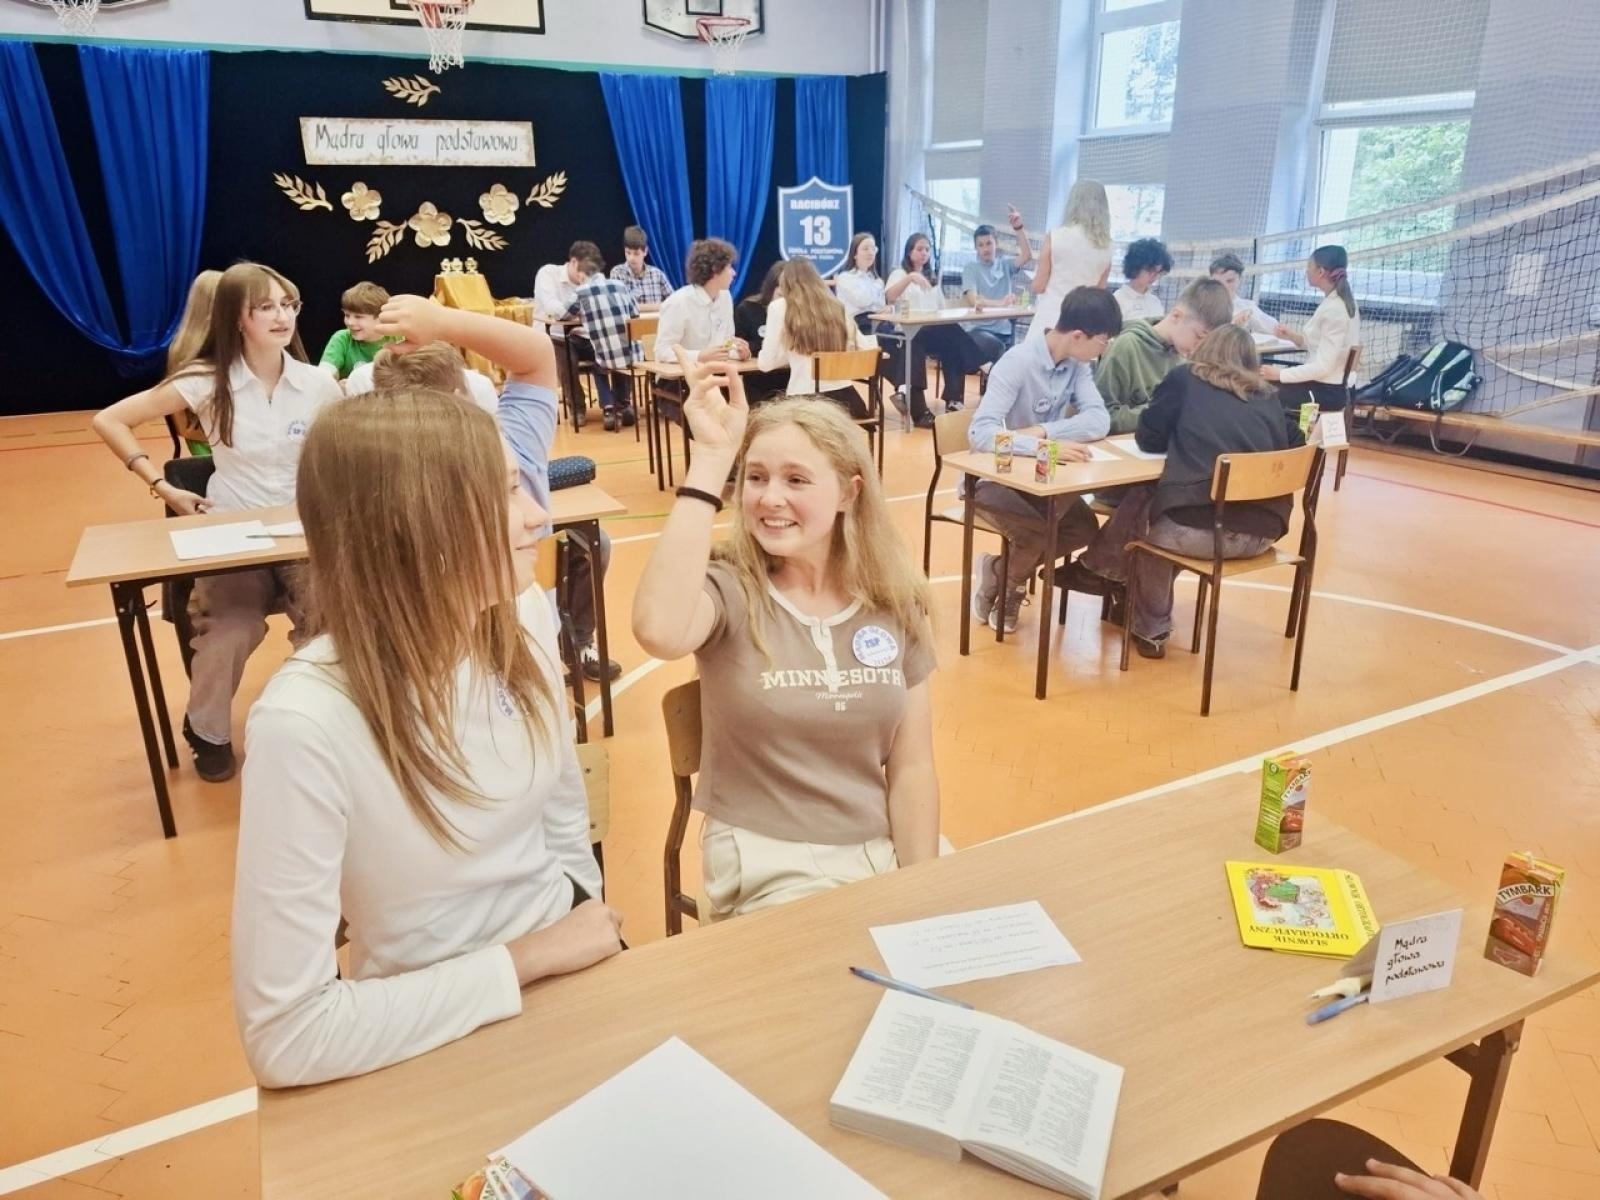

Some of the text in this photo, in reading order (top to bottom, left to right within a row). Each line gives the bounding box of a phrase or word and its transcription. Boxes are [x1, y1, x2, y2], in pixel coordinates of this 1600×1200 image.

[314, 124, 518, 158] Mądra głowa podstawowa
[790, 197, 840, 210] RACIBÓRZ
[799, 215, 831, 246] 13
[1498, 884, 1551, 900] TYMBARK
[1249, 925, 1350, 941] ORTOGRAFICZNY
